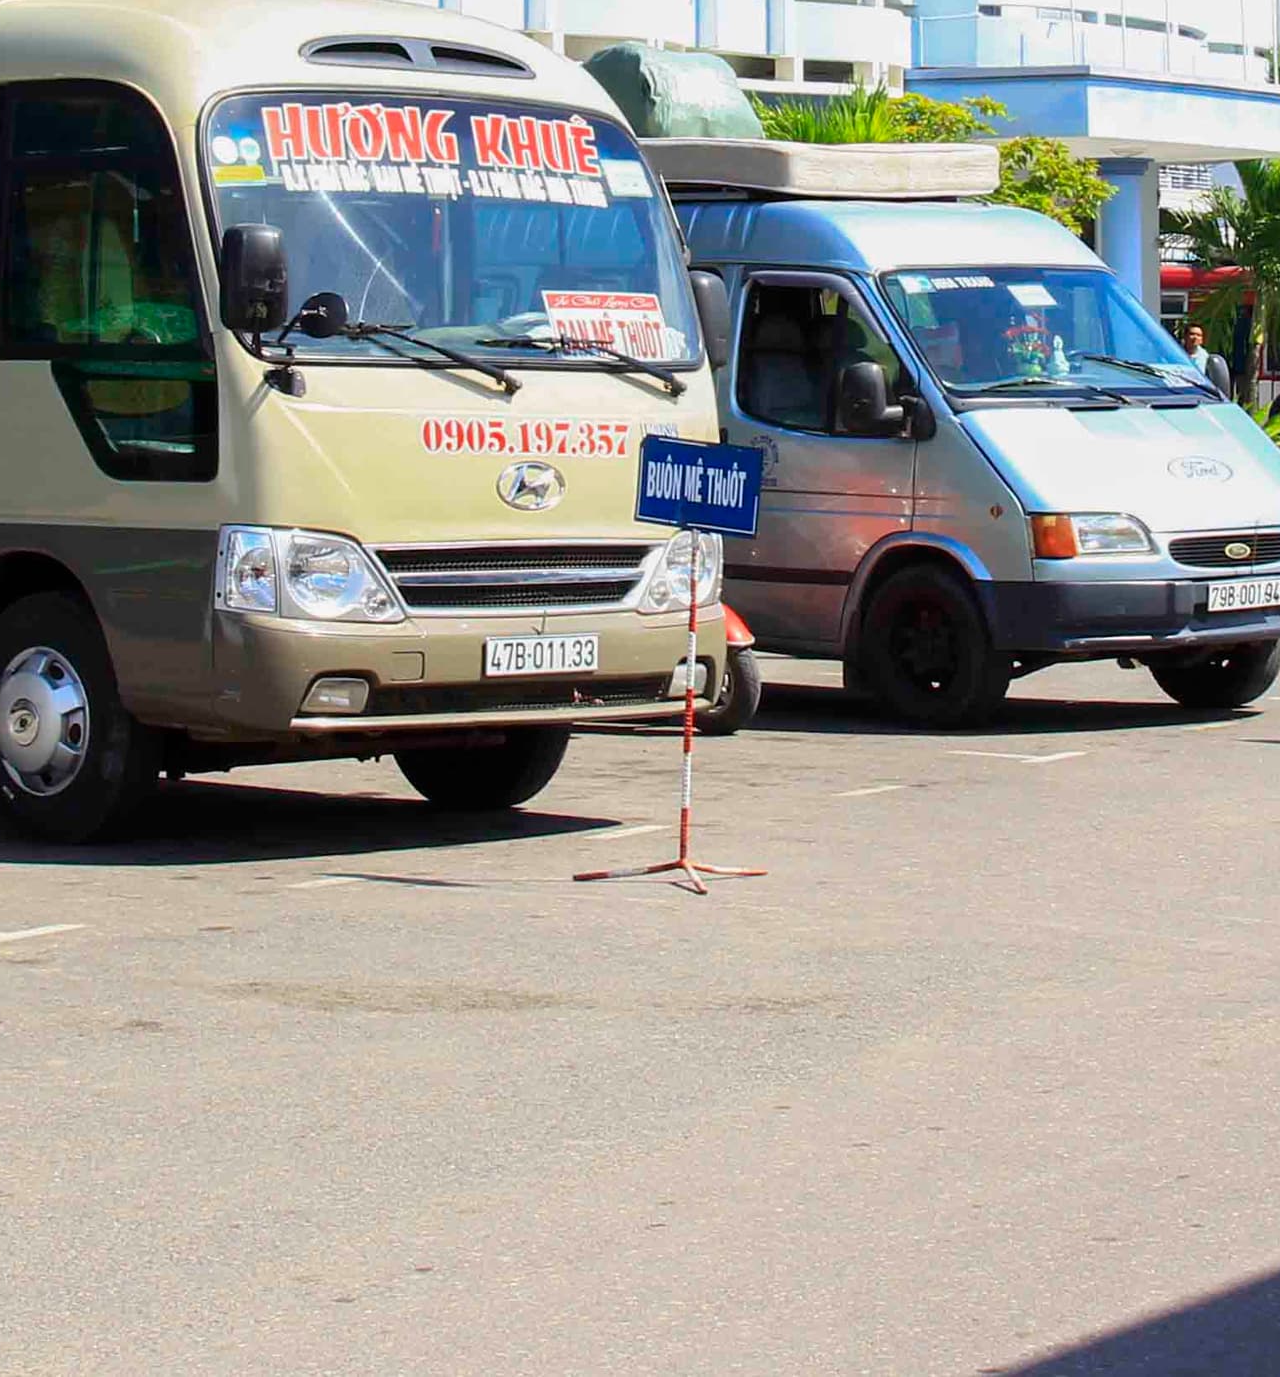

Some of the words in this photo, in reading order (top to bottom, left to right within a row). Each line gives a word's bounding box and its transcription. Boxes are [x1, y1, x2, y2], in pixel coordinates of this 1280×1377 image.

[470, 114, 601, 177] KHUÊ
[422, 419, 629, 457] 0905.197.357
[646, 454, 683, 501] BUÔN
[684, 457, 704, 503] MÊ
